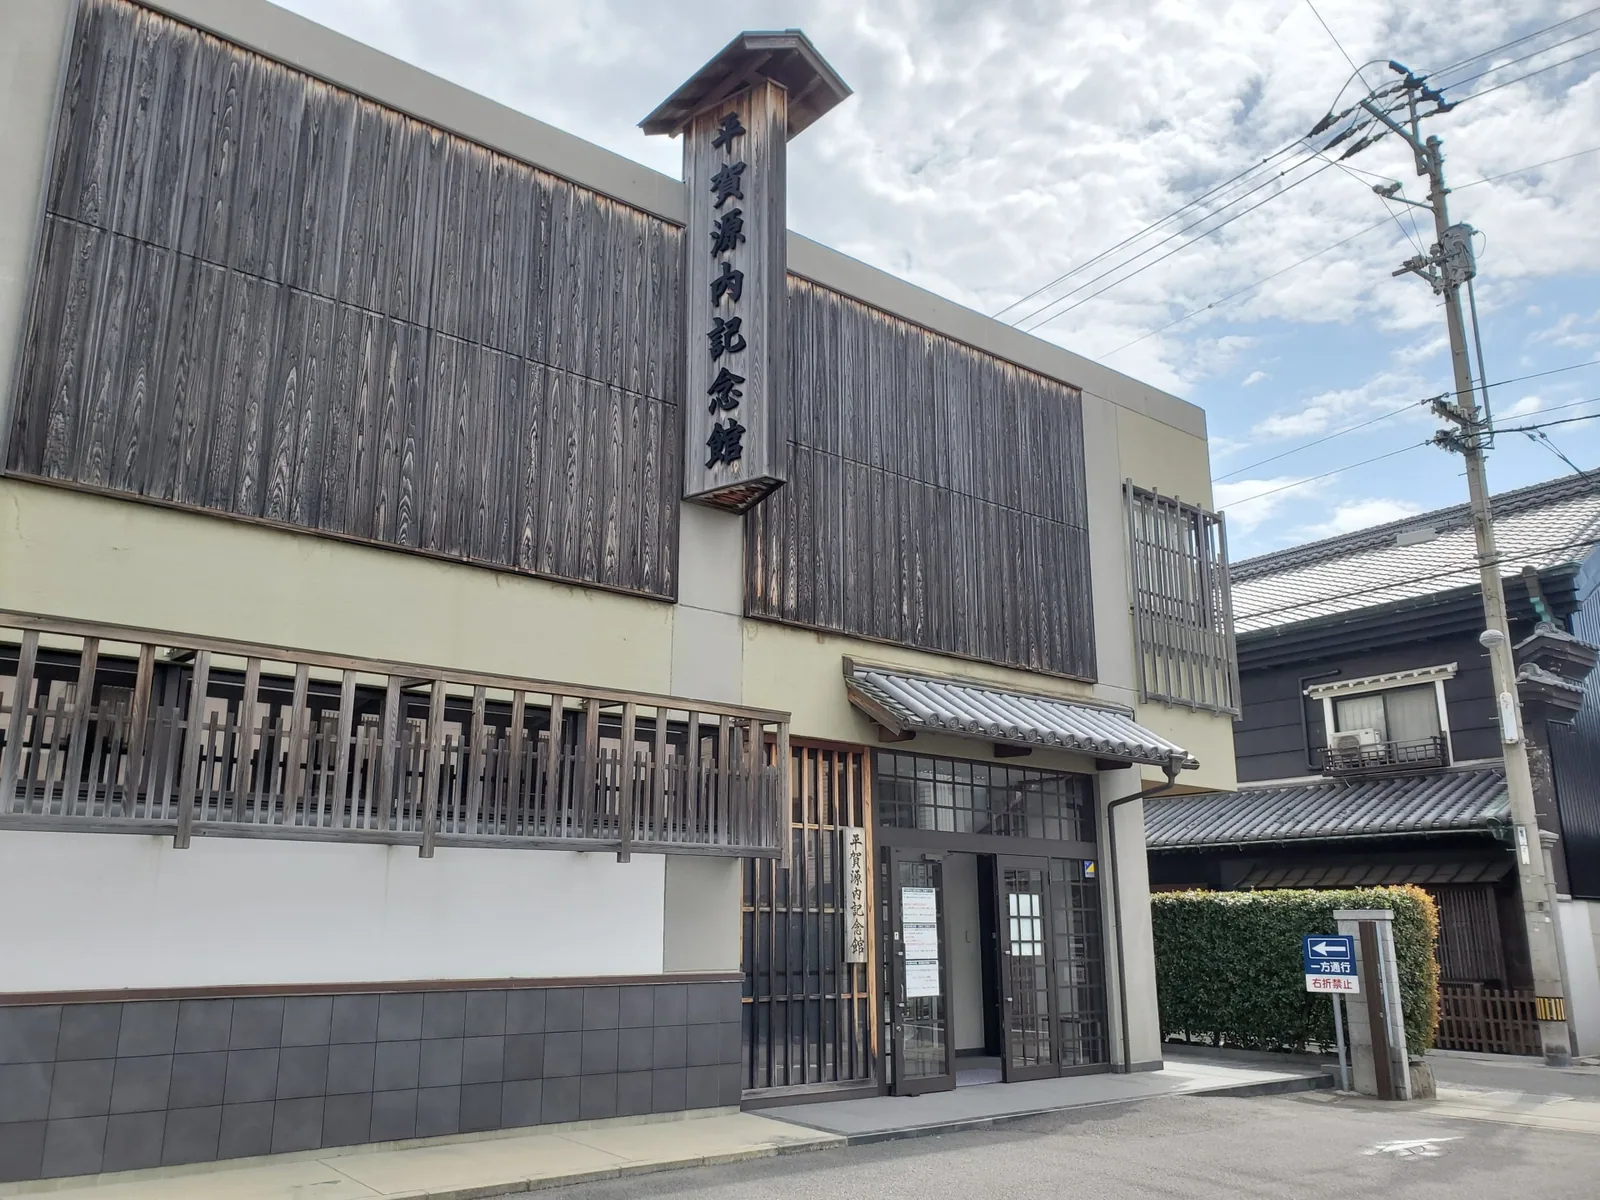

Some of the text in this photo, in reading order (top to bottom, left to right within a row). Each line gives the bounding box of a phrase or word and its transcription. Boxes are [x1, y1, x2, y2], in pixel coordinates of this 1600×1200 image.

[705, 111, 747, 469] 平賀源内記念館
[849, 833, 865, 955] 平賀源内記念館
[1310, 961, 1351, 973] 一方通行
[1312, 978, 1353, 990] 右折禁止
